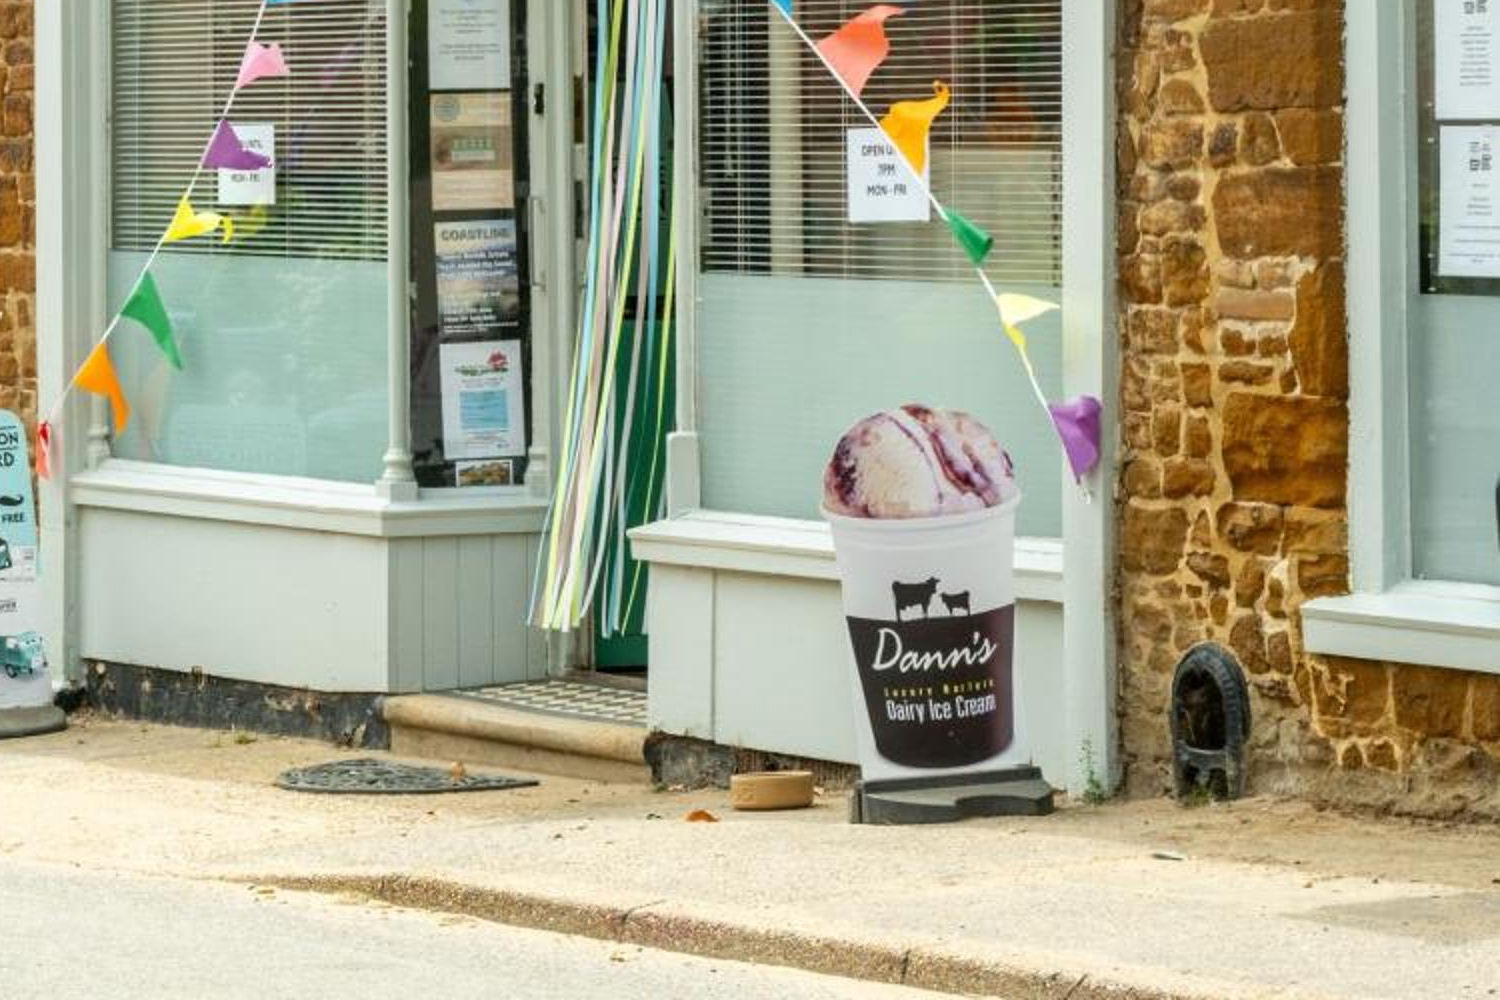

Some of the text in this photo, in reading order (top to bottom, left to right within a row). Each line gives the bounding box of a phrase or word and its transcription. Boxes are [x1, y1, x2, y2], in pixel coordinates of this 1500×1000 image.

[861, 144, 885, 157] OPEN
[2, 512, 24, 523] FREE
[872, 627, 997, 673] Dann's
[886, 694, 997, 723] Dairy Ice Cream
